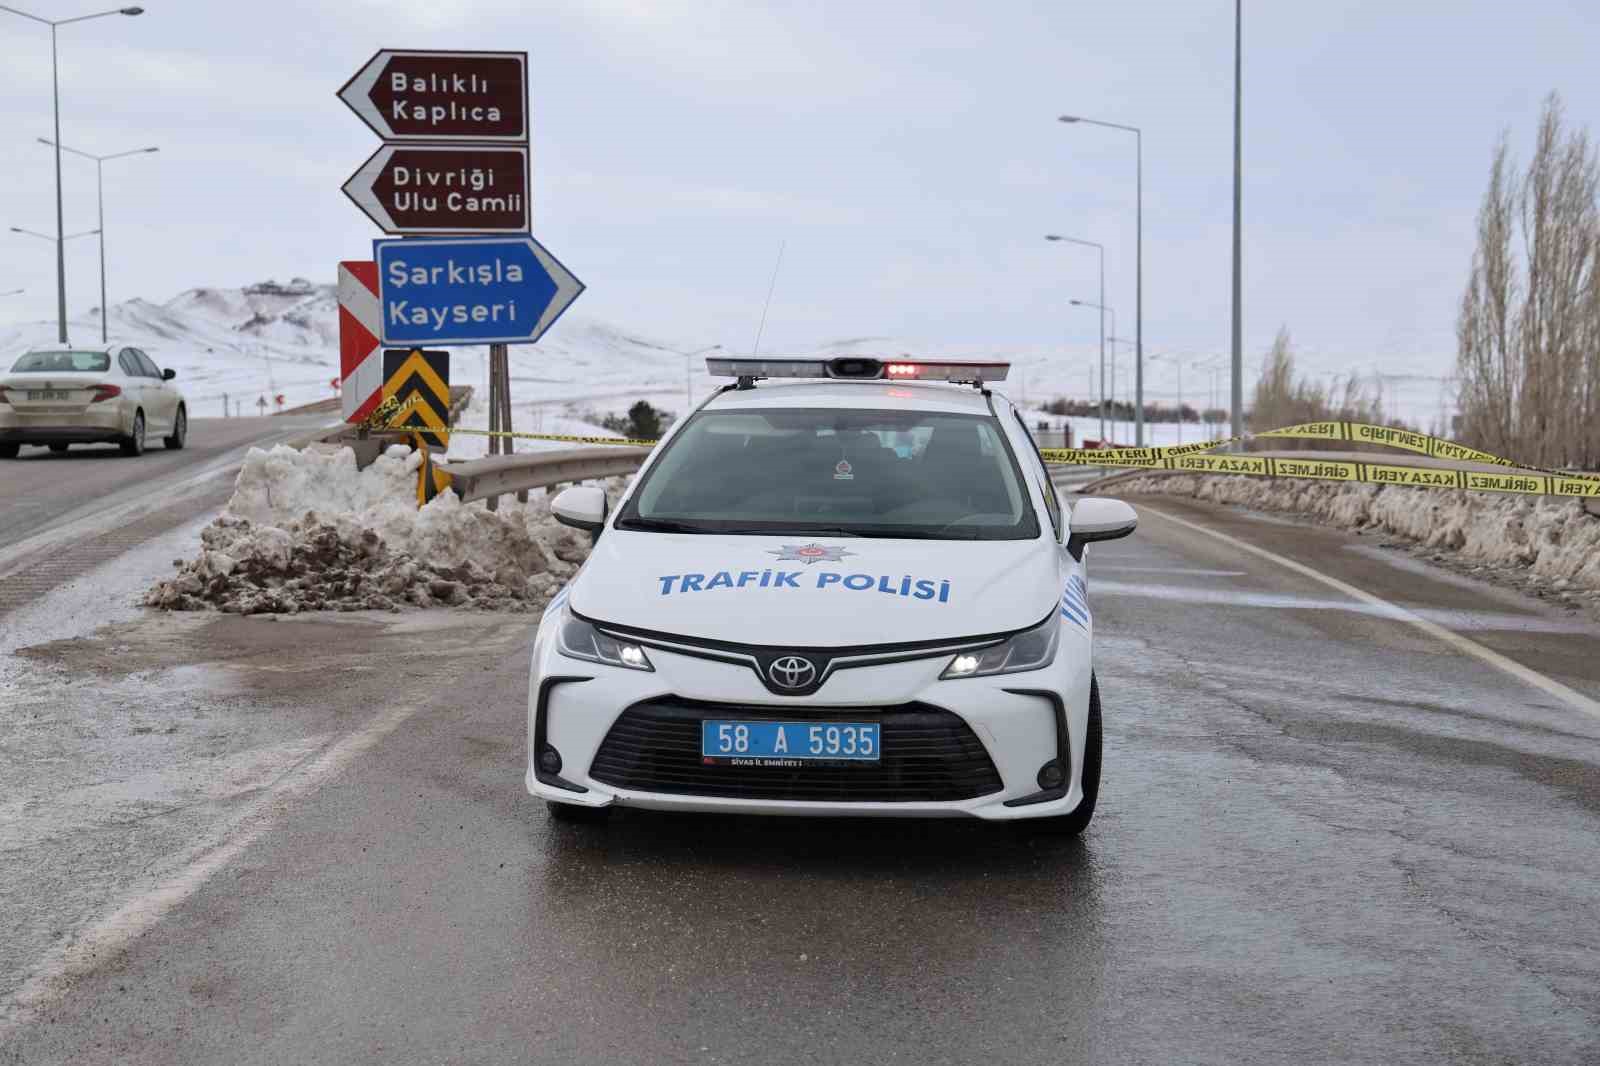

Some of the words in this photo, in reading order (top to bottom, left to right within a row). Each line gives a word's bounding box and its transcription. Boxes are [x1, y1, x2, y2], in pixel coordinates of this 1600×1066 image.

[391, 72, 488, 93] Balıklı
[392, 101, 501, 125] Kaplıca
[393, 167, 494, 190] Divriği
[394, 192, 438, 211] Ulu
[446, 193, 521, 212] Camii
[388, 259, 523, 288] Şarkışla
[389, 300, 516, 331] Kayseri
[658, 568, 802, 596] TRAFİK
[815, 572, 951, 604] POLİSİ
[719, 724, 749, 753] 58
[774, 726, 788, 753] A
[809, 726, 873, 755] 5935
